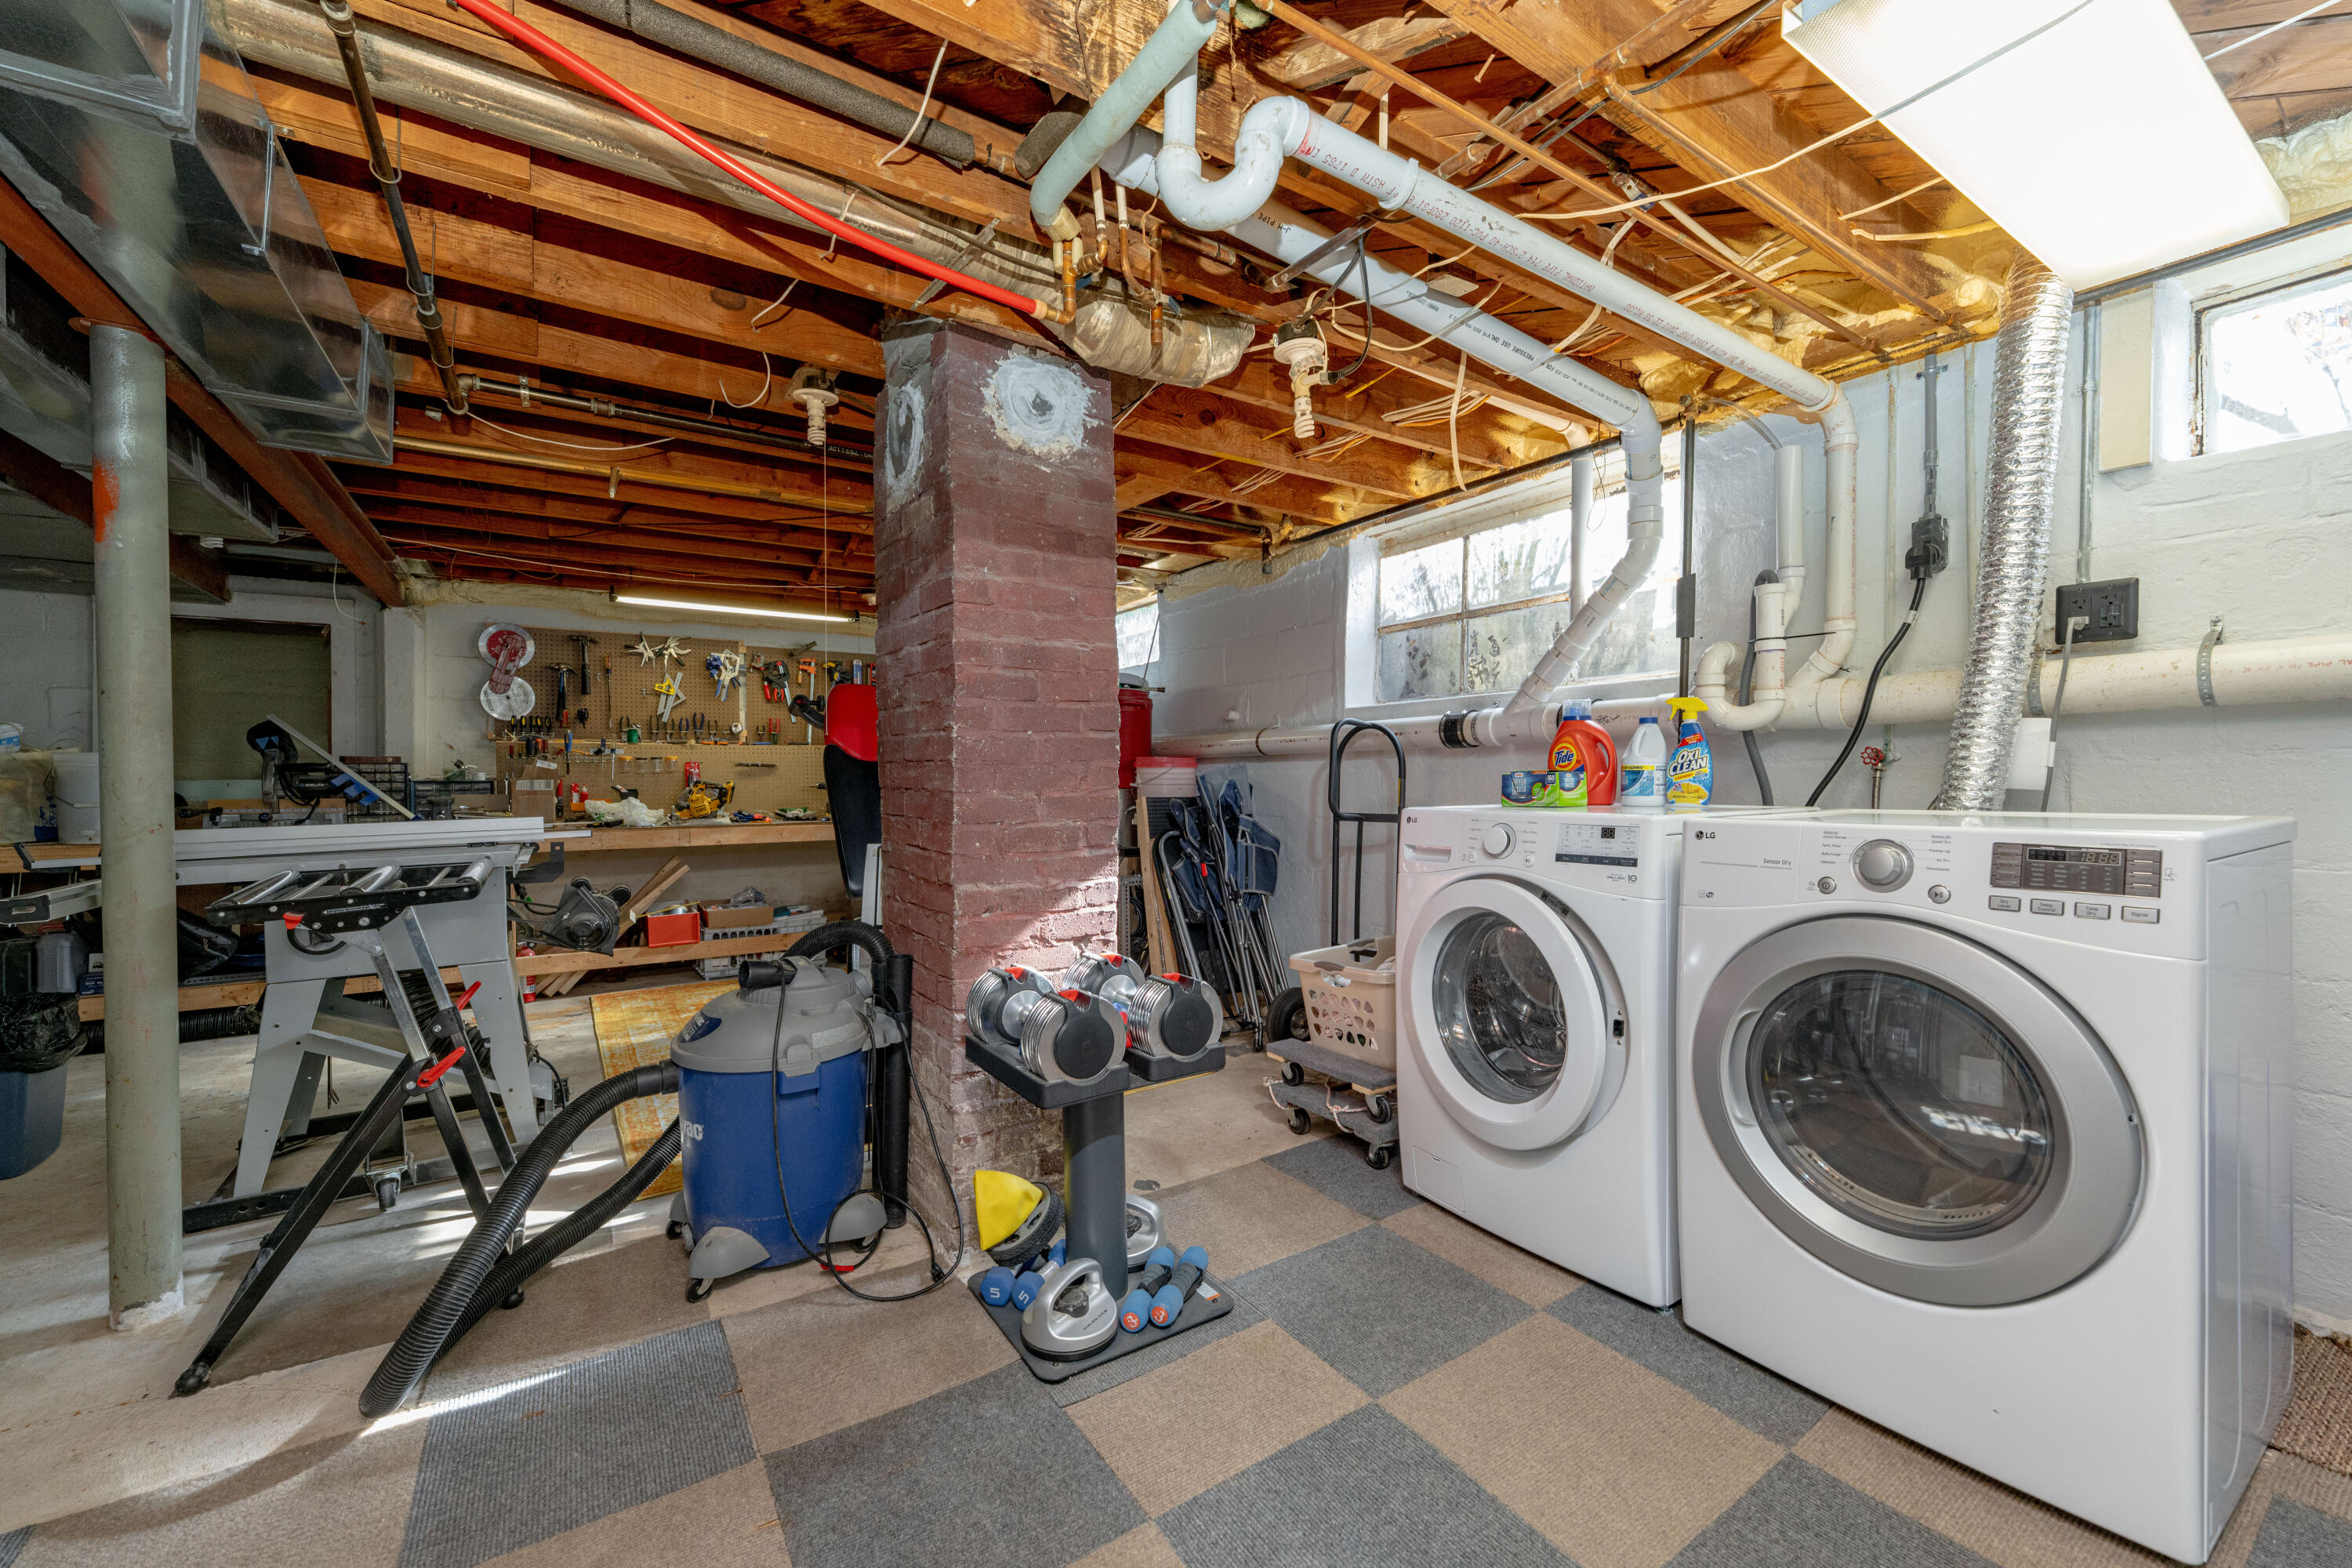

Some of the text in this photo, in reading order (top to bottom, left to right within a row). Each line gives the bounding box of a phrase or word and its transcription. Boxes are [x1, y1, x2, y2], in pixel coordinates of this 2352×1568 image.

[1321, 152, 1348, 172] 1785
[1349, 166, 1359, 178] D
[1359, 171, 1386, 191] ASTM
[1416, 198, 1450, 222] 280PSI
[1257, 212, 1276, 226] PIPE
[1541, 260, 1563, 278] PIPE
[1561, 270, 1595, 294] NATIONAL
[1486, 332, 1535, 361] PRESSURE USE ONLY
[1544, 362, 1555, 372] FOR
[1555, 750, 1574, 767] Tide
[1678, 750, 1699, 763] OXI
[1669, 757, 1707, 775] CLEAN
[990, 1288, 1000, 1298] 5
[1018, 1290, 1029, 1304] 5
[1155, 1310, 1165, 1322] 3
